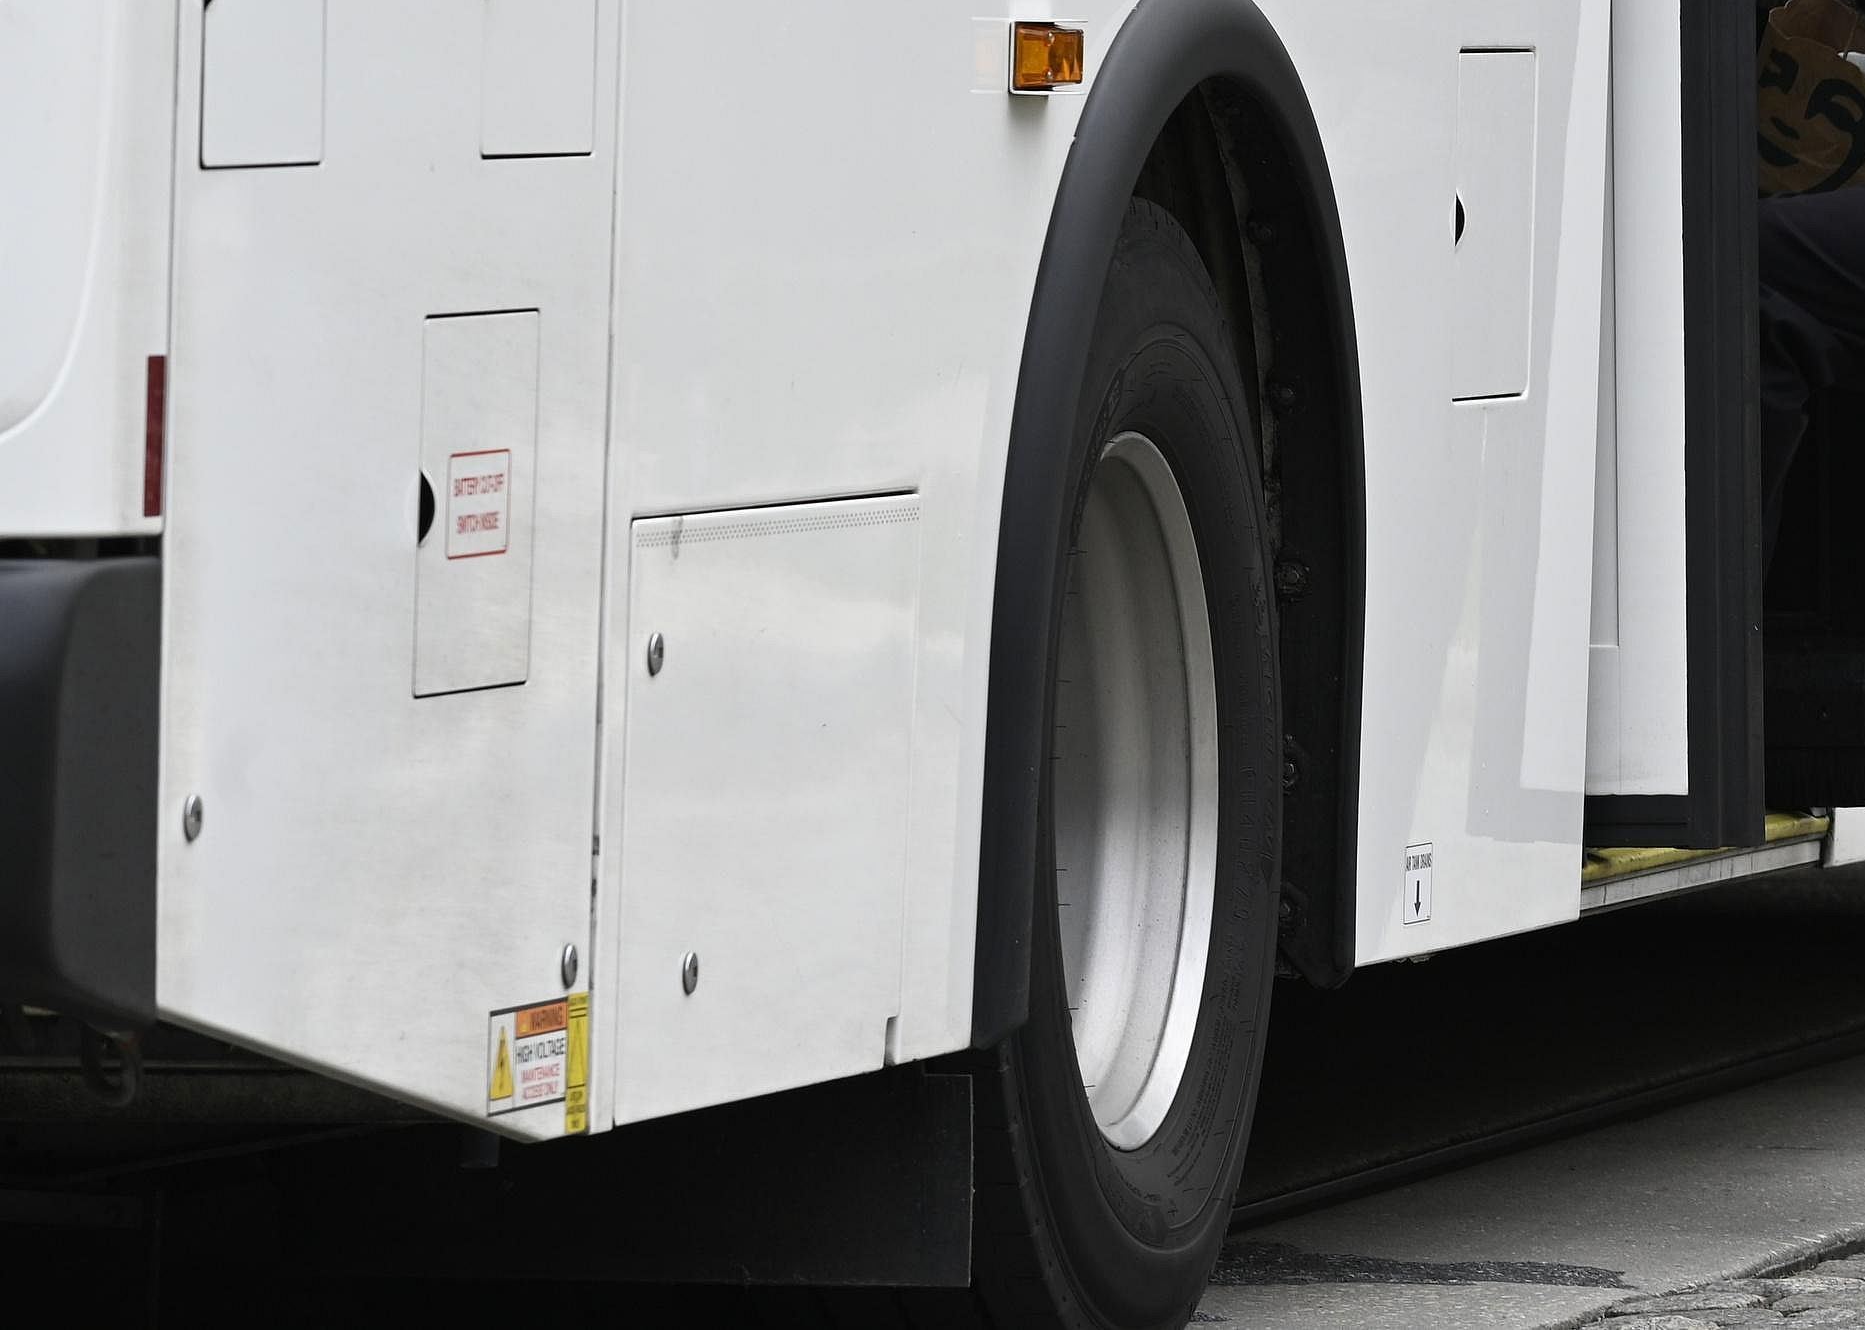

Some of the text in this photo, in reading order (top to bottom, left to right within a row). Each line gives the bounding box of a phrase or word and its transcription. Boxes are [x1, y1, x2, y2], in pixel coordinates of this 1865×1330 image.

[454, 476, 480, 497] BATTERY
[529, 1005, 563, 1030] WARNING
[515, 1037, 567, 1064] HIGH VOLTAGE
[521, 1063, 560, 1083] MAINTENANCE
